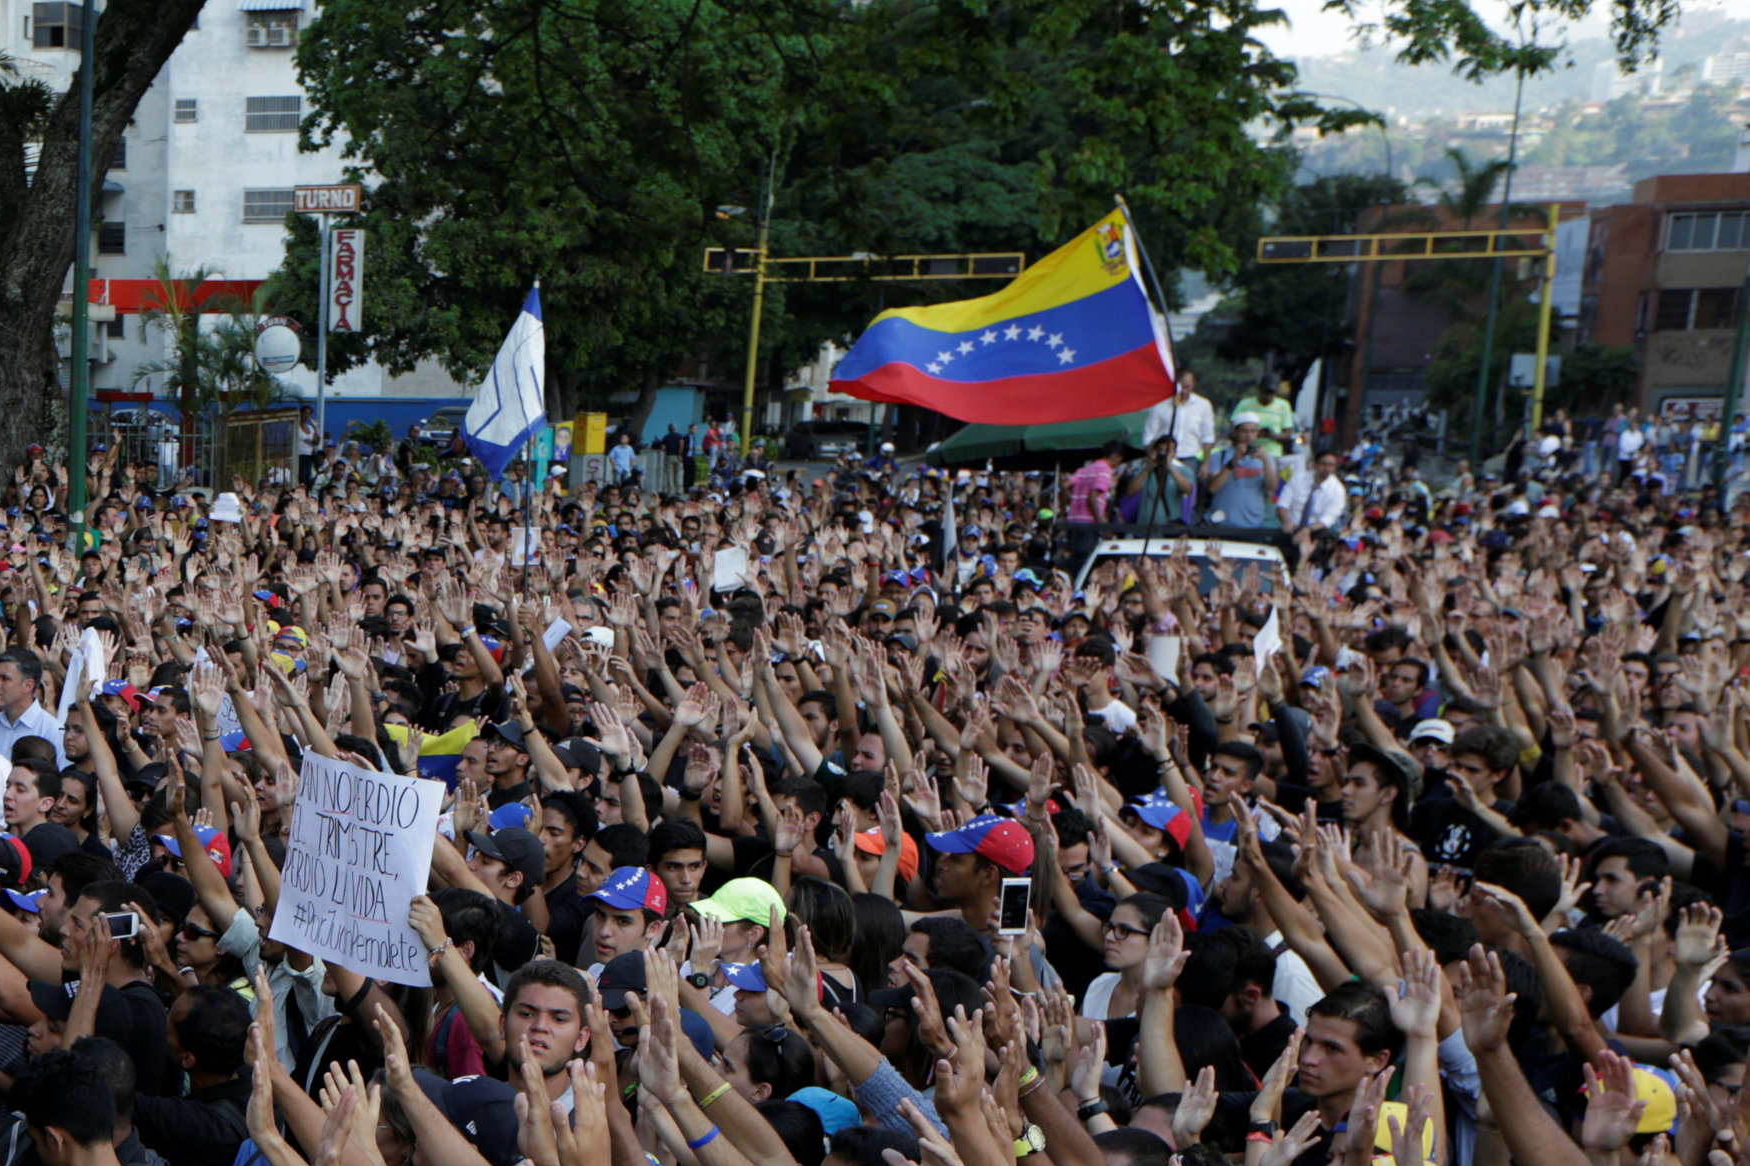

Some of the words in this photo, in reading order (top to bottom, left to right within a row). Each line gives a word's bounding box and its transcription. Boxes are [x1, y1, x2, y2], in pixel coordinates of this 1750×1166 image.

[296, 188, 355, 208] TURNO
[333, 231, 356, 331] FARMACIA
[323, 767, 351, 813] NO
[315, 811, 399, 881] TRIMSTRE,
[351, 871, 387, 922] VIDA
